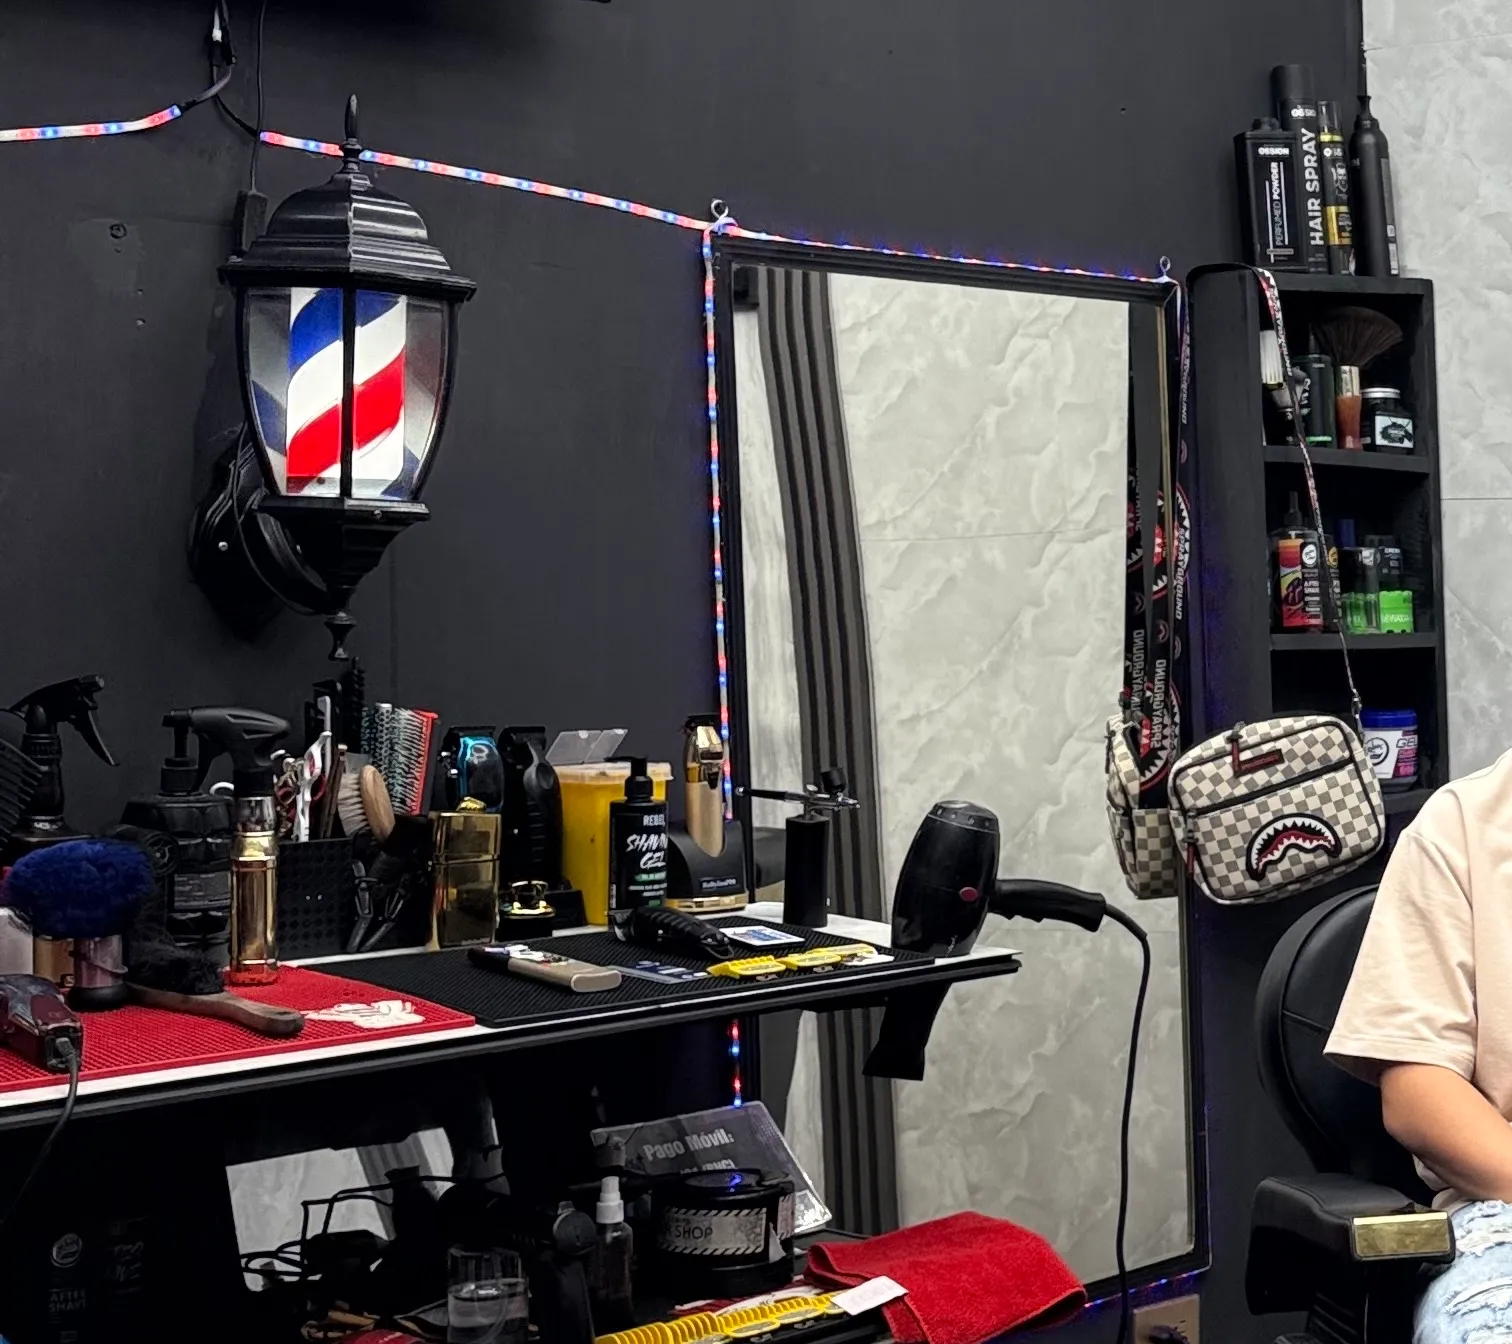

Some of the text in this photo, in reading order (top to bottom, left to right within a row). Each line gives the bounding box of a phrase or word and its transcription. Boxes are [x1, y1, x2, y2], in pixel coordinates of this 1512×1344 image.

[1270, 161, 1282, 200] POWDER
[1301, 128, 1325, 246] HAIR SPRAY
[642, 1140, 686, 1162] Pago
[674, 1224, 714, 1239] SHOP
